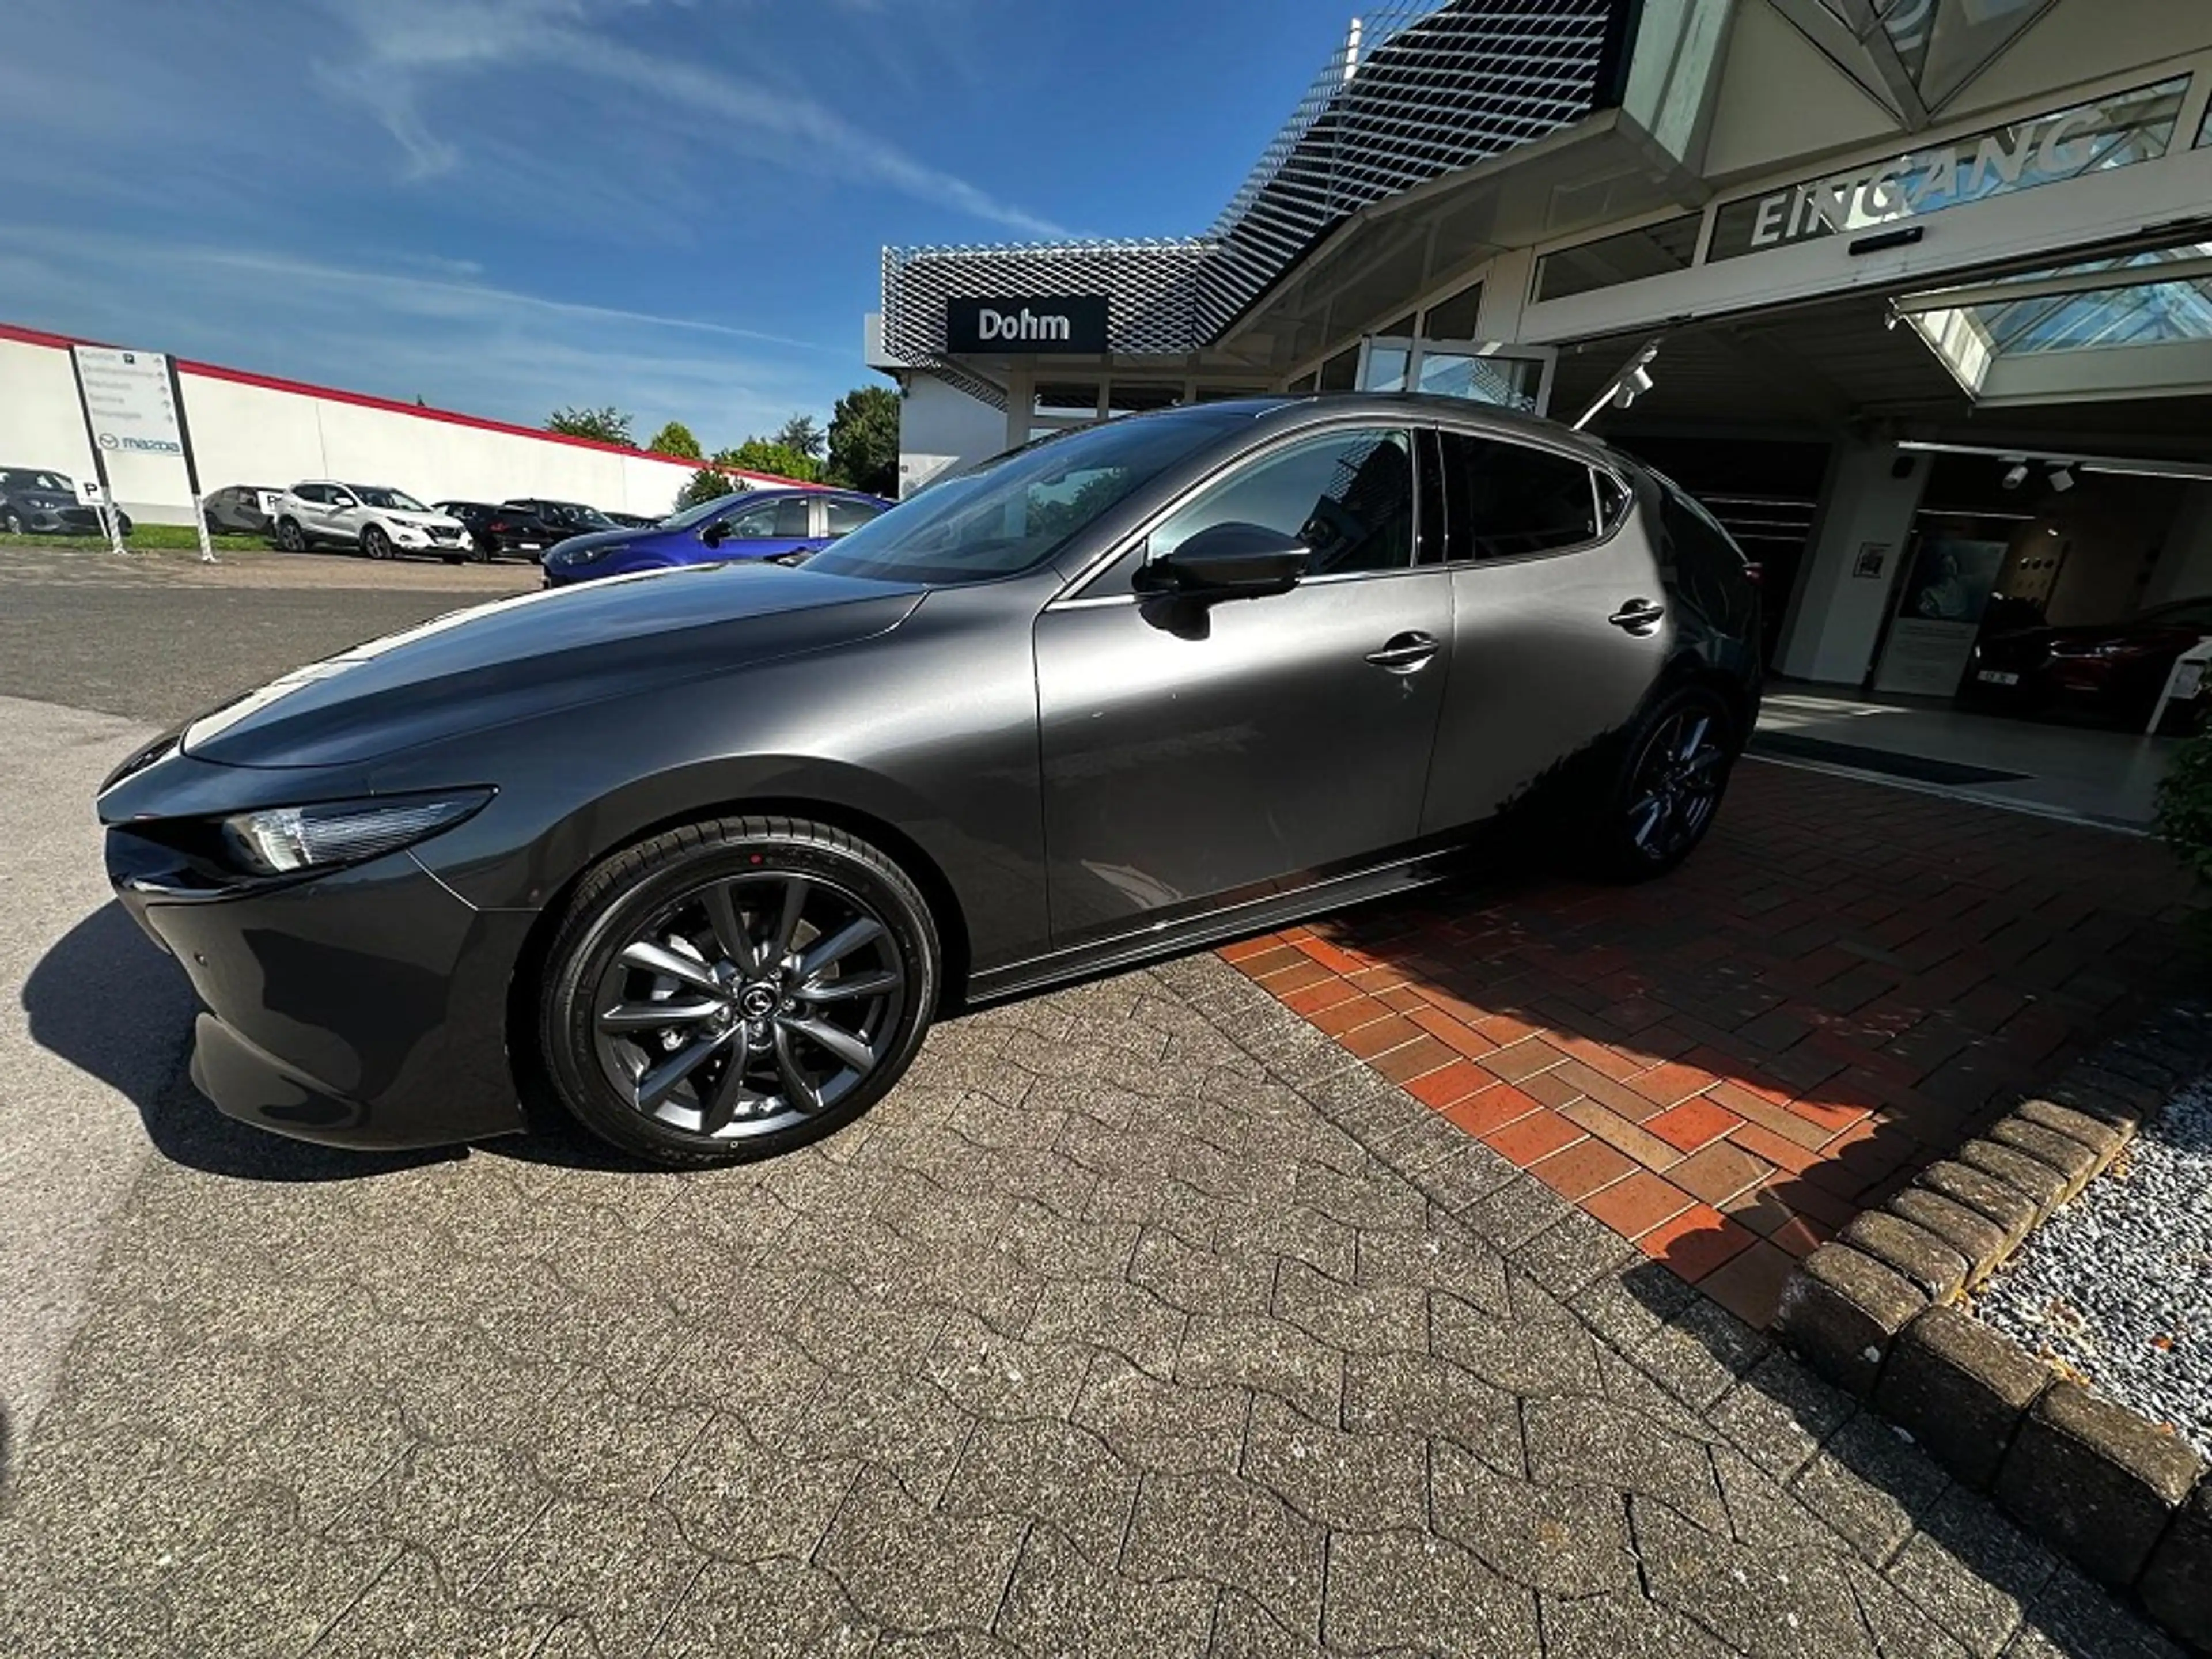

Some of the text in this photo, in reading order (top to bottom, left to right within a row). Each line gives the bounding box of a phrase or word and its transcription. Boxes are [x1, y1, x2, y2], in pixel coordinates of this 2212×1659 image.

[1751, 111, 2104, 247] EINGANG
[979, 308, 1070, 340] Dohm
[84, 482, 97, 496] P
